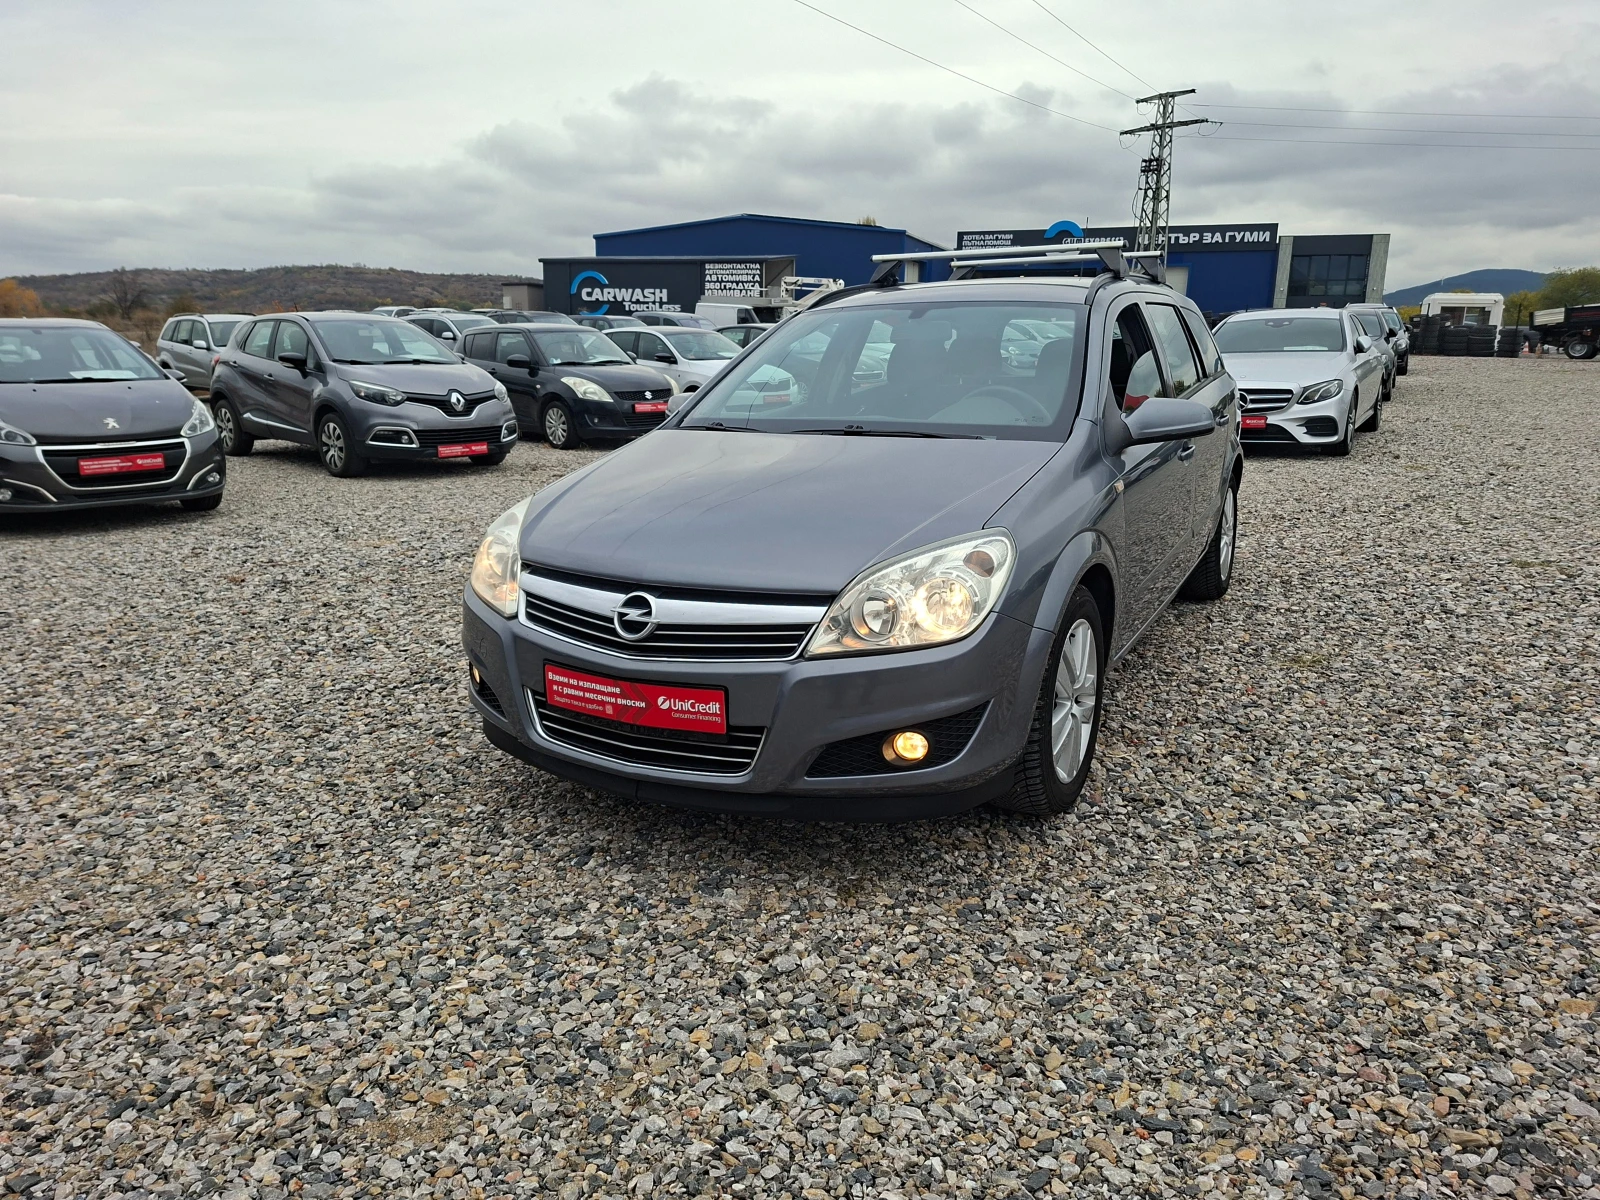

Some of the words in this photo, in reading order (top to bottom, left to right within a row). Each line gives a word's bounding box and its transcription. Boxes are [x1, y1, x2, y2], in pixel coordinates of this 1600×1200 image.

[1202, 232, 1224, 244] ЗА
[1225, 231, 1270, 243] ГУМИ
[704, 282, 720, 290] 360
[721, 282, 760, 290] ГРАДУСА
[581, 287, 668, 302] CARWASH
[704, 289, 760, 298] ИЗМИВАНЕ
[623, 301, 682, 312] TouchLess
[548, 671, 569, 684] Вземи
[569, 678, 578, 686] на
[578, 680, 621, 694] изплащане
[563, 687, 584, 698] равни
[584, 691, 616, 704] месечни
[617, 698, 646, 709] вноски
[671, 698, 721, 714] UniCredit
[671, 711, 697, 719] Consumer
[697, 714, 721, 723] Financing
